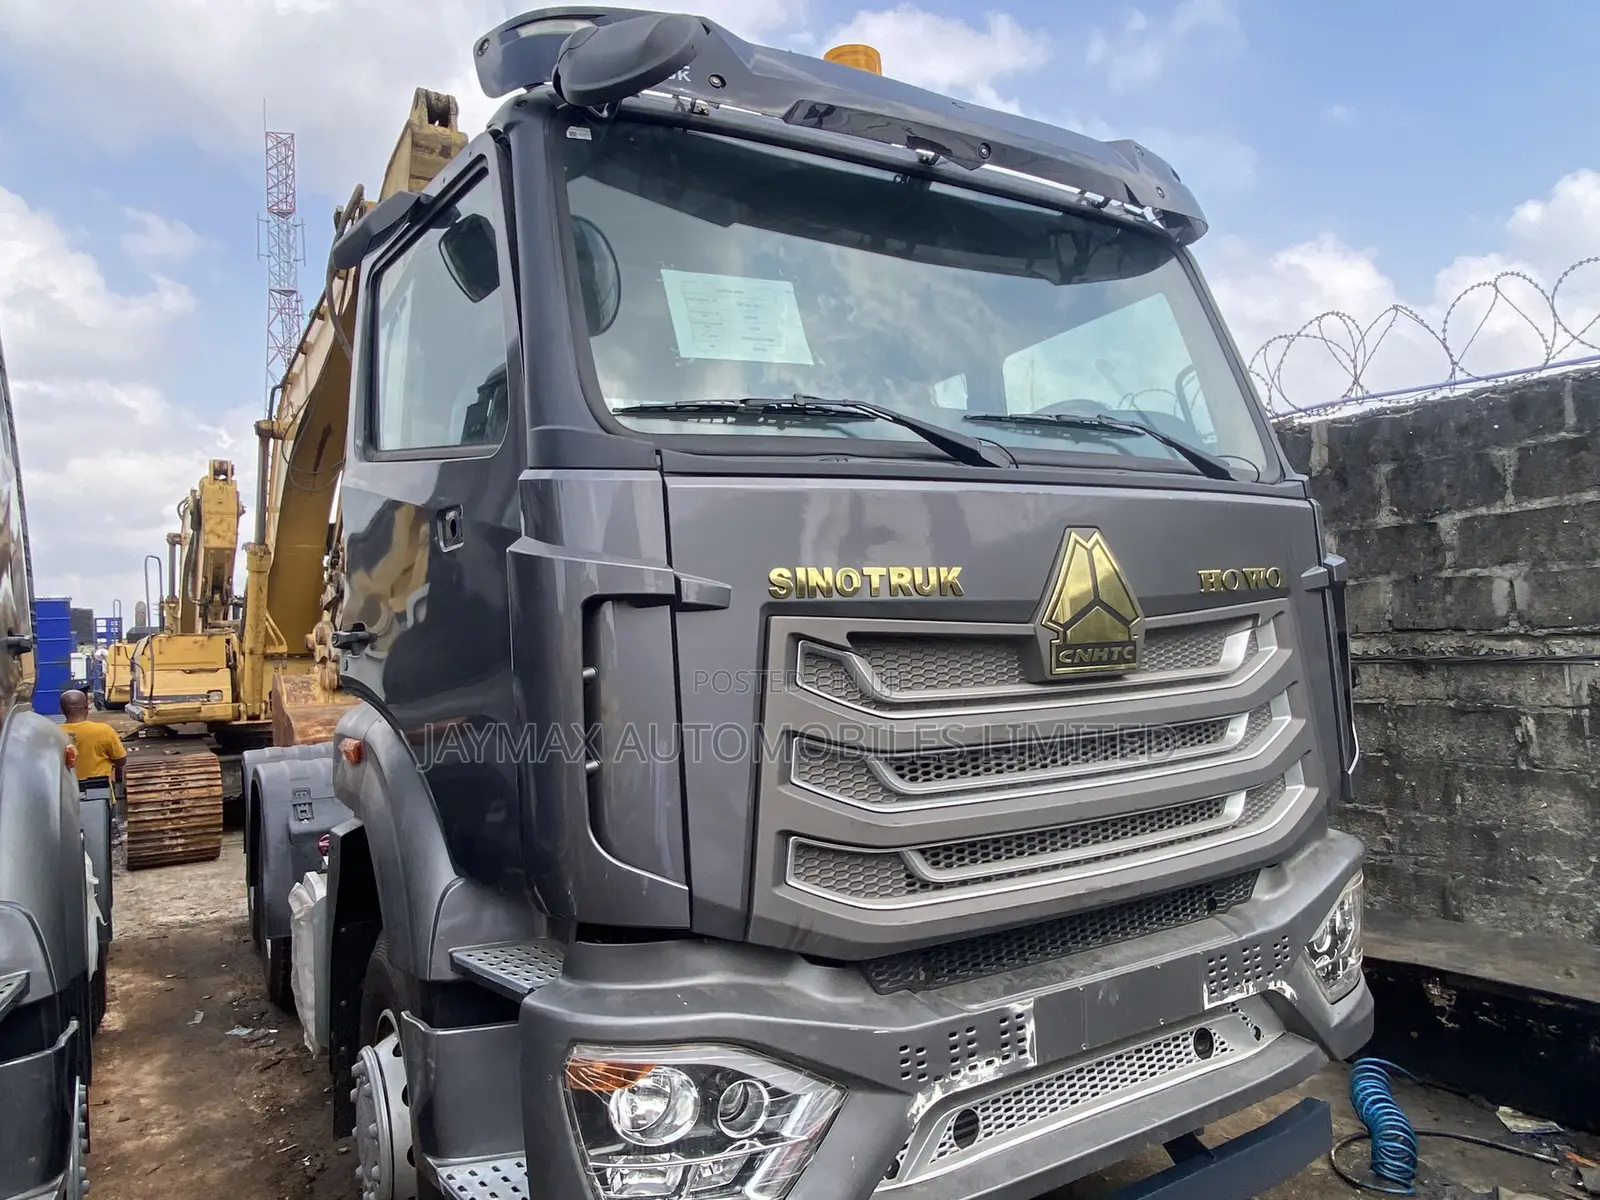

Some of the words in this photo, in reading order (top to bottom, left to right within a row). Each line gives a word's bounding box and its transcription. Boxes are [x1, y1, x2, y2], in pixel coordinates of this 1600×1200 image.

[767, 566, 964, 599] SINOTRUK
[1197, 566, 1283, 593] HOWO
[1058, 645, 1134, 665] CNHTC
